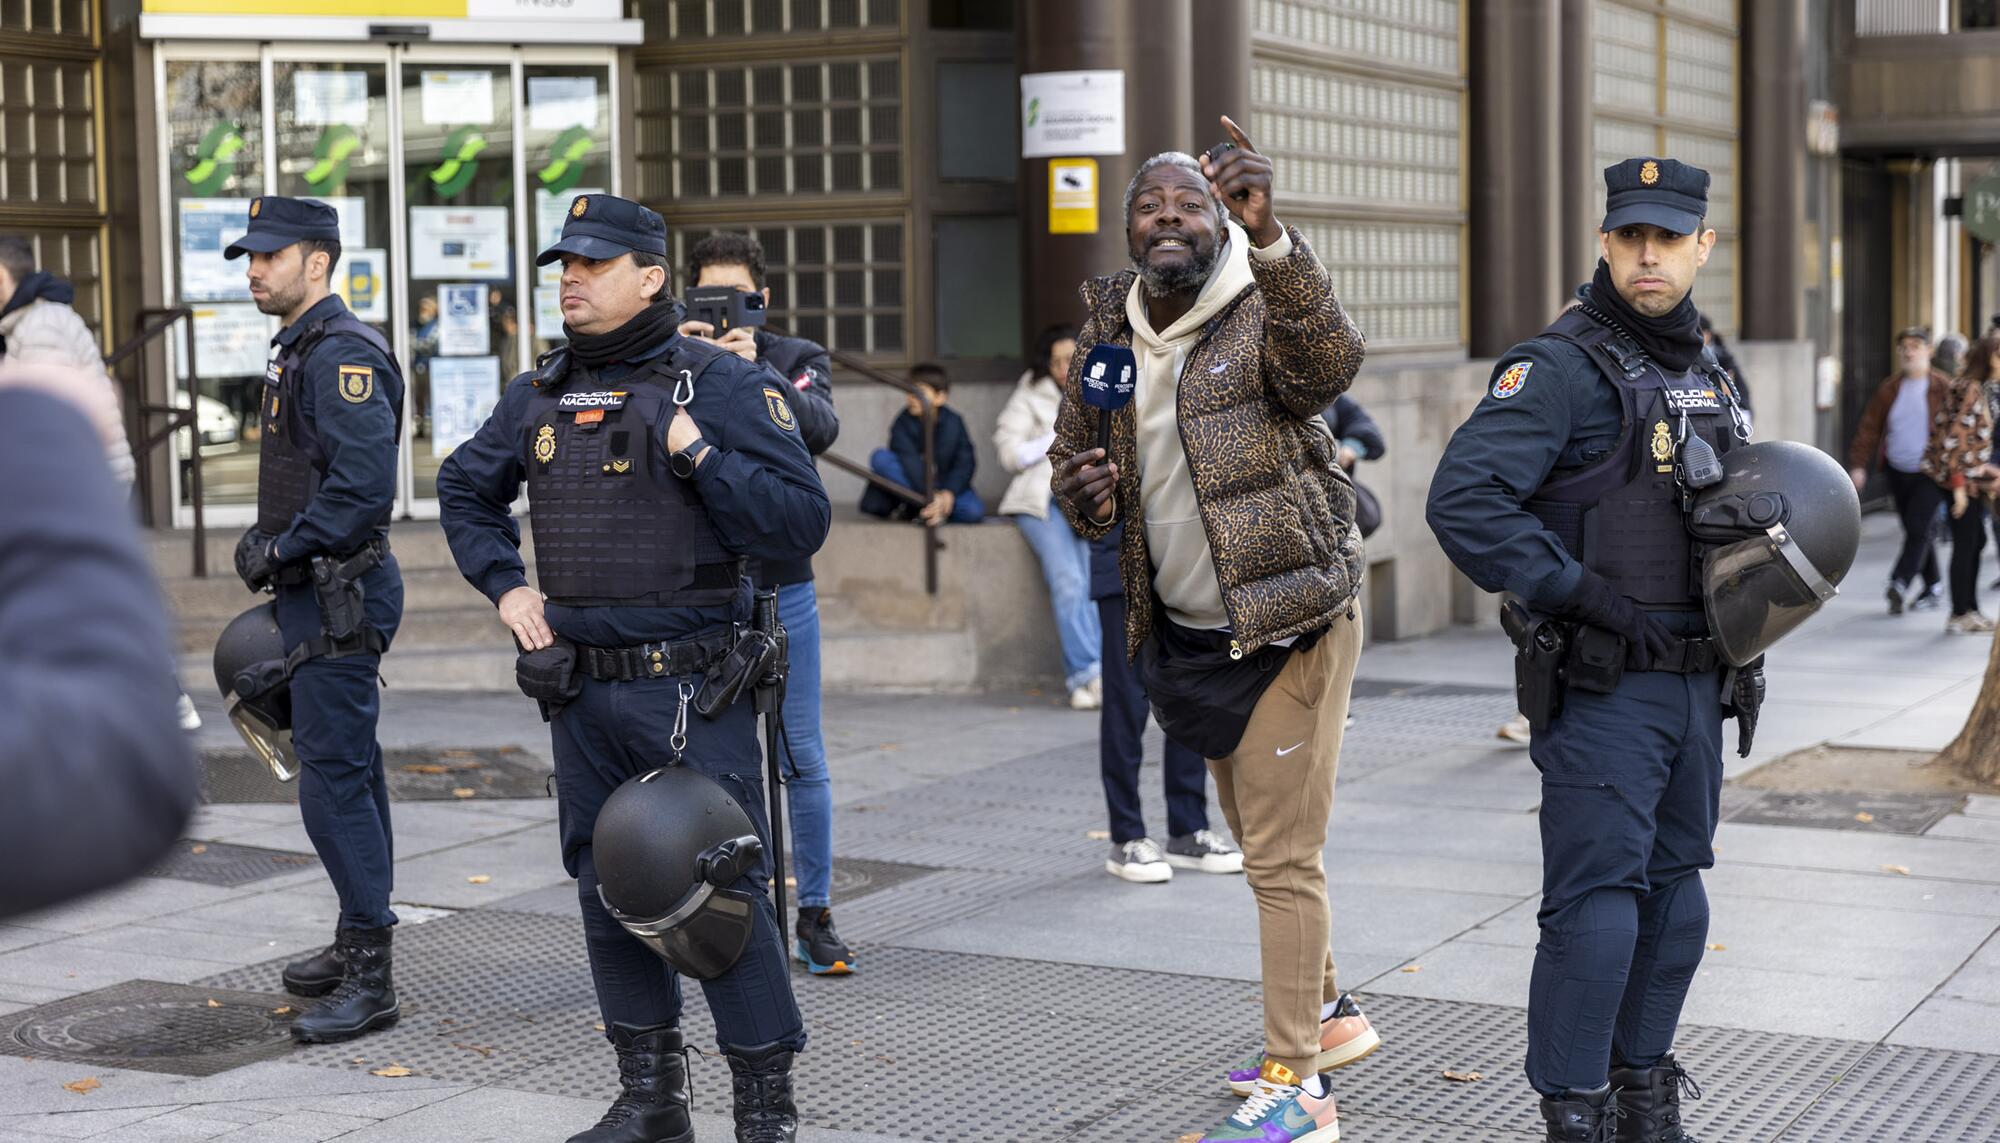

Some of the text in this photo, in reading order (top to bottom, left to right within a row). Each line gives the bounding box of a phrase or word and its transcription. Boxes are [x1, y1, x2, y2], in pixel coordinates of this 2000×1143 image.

[1665, 389, 1707, 399] POLICIA
[559, 397, 622, 406] NACIONAL
[1669, 398, 1720, 408] NACIONAL
